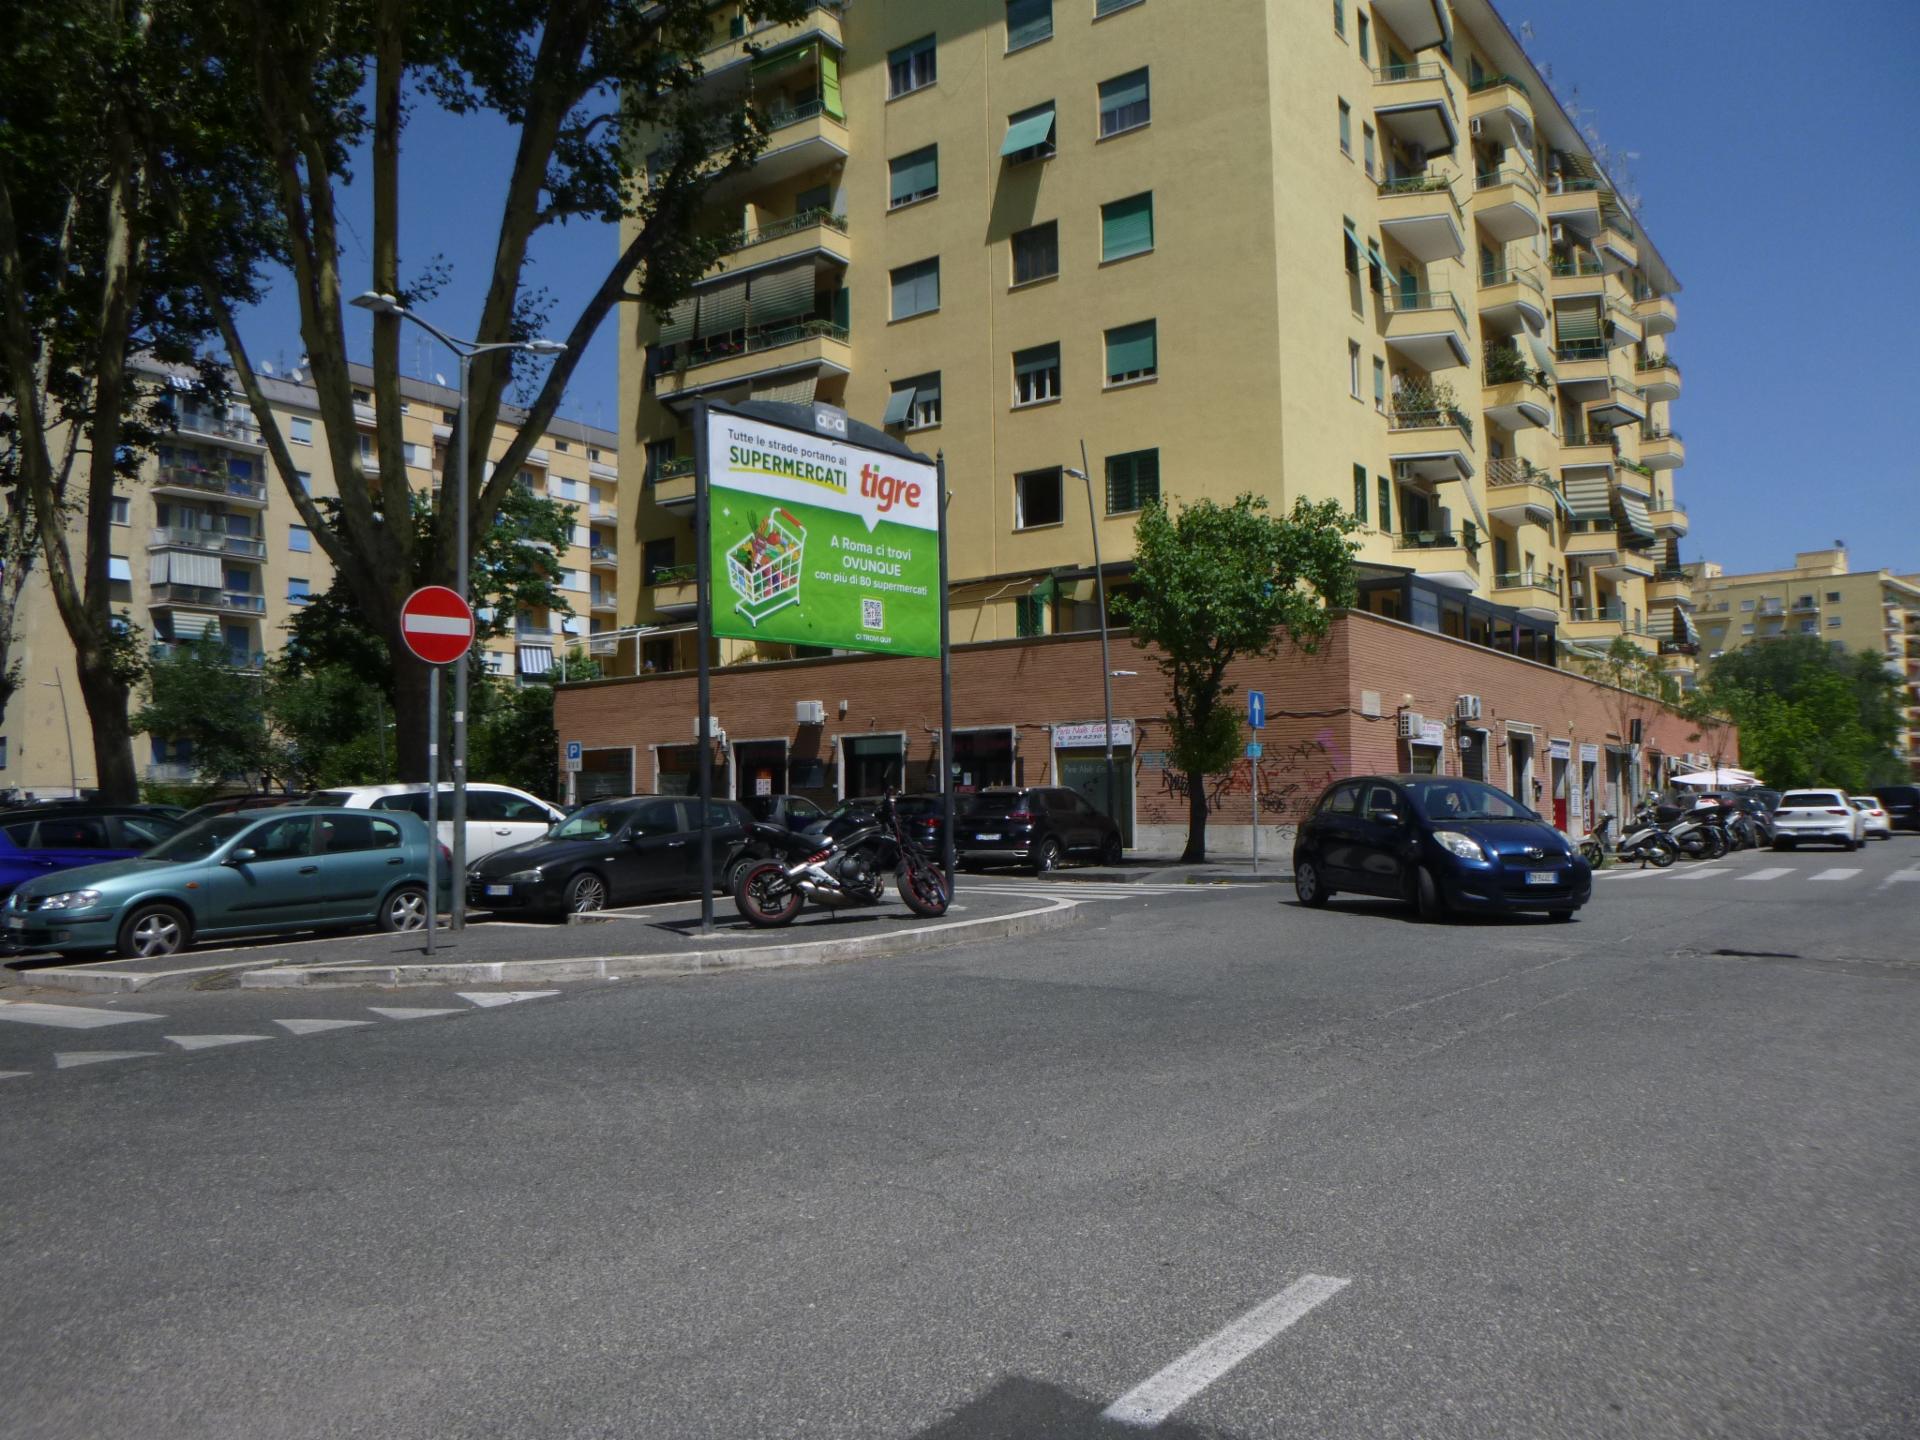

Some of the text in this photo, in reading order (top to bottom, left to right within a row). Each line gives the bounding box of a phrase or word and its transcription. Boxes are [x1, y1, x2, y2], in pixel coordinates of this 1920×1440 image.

[728, 428, 847, 466] Tutte le strade portano ai
[729, 445, 847, 487] SUPERMERCATI
[860, 463, 922, 512] tigre
[831, 535, 912, 561] A Roma ci trovi
[843, 555, 902, 577] OVUNQUE
[815, 570, 832, 581] con
[850, 574, 858, 585] di
[860, 575, 872, 587] 80
[873, 579, 928, 596] supermercati
[570, 745, 578, 758] P
